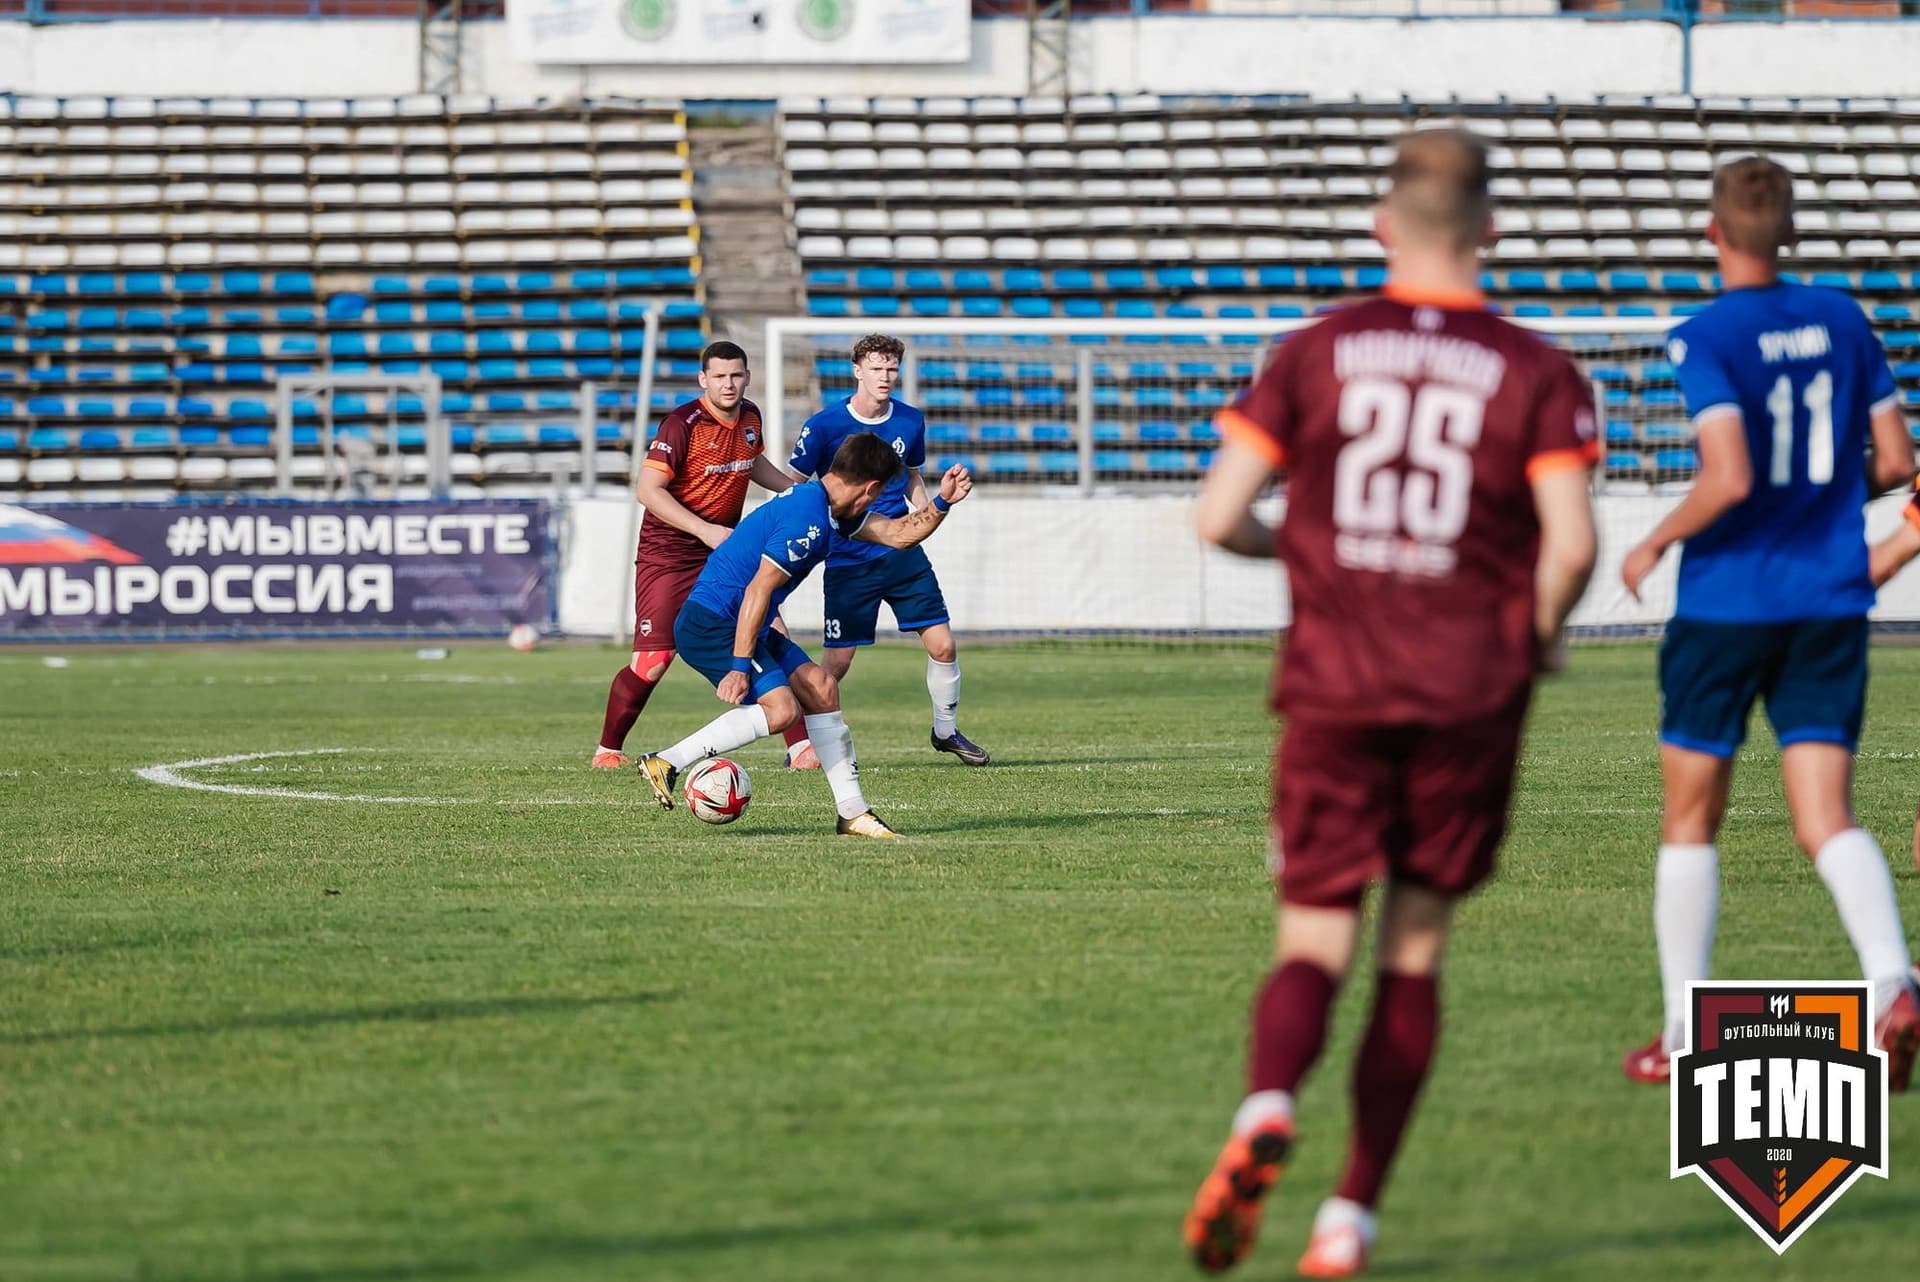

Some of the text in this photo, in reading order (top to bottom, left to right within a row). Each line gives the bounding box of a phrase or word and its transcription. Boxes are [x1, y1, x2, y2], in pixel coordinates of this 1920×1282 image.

[1766, 369, 1834, 486] 11
[1332, 378, 1487, 545] 25
[166, 514, 531, 556] #МЫВМЕСТЕ
[0, 564, 394, 616] МЫРОССИЯ
[825, 618, 841, 639] 33
